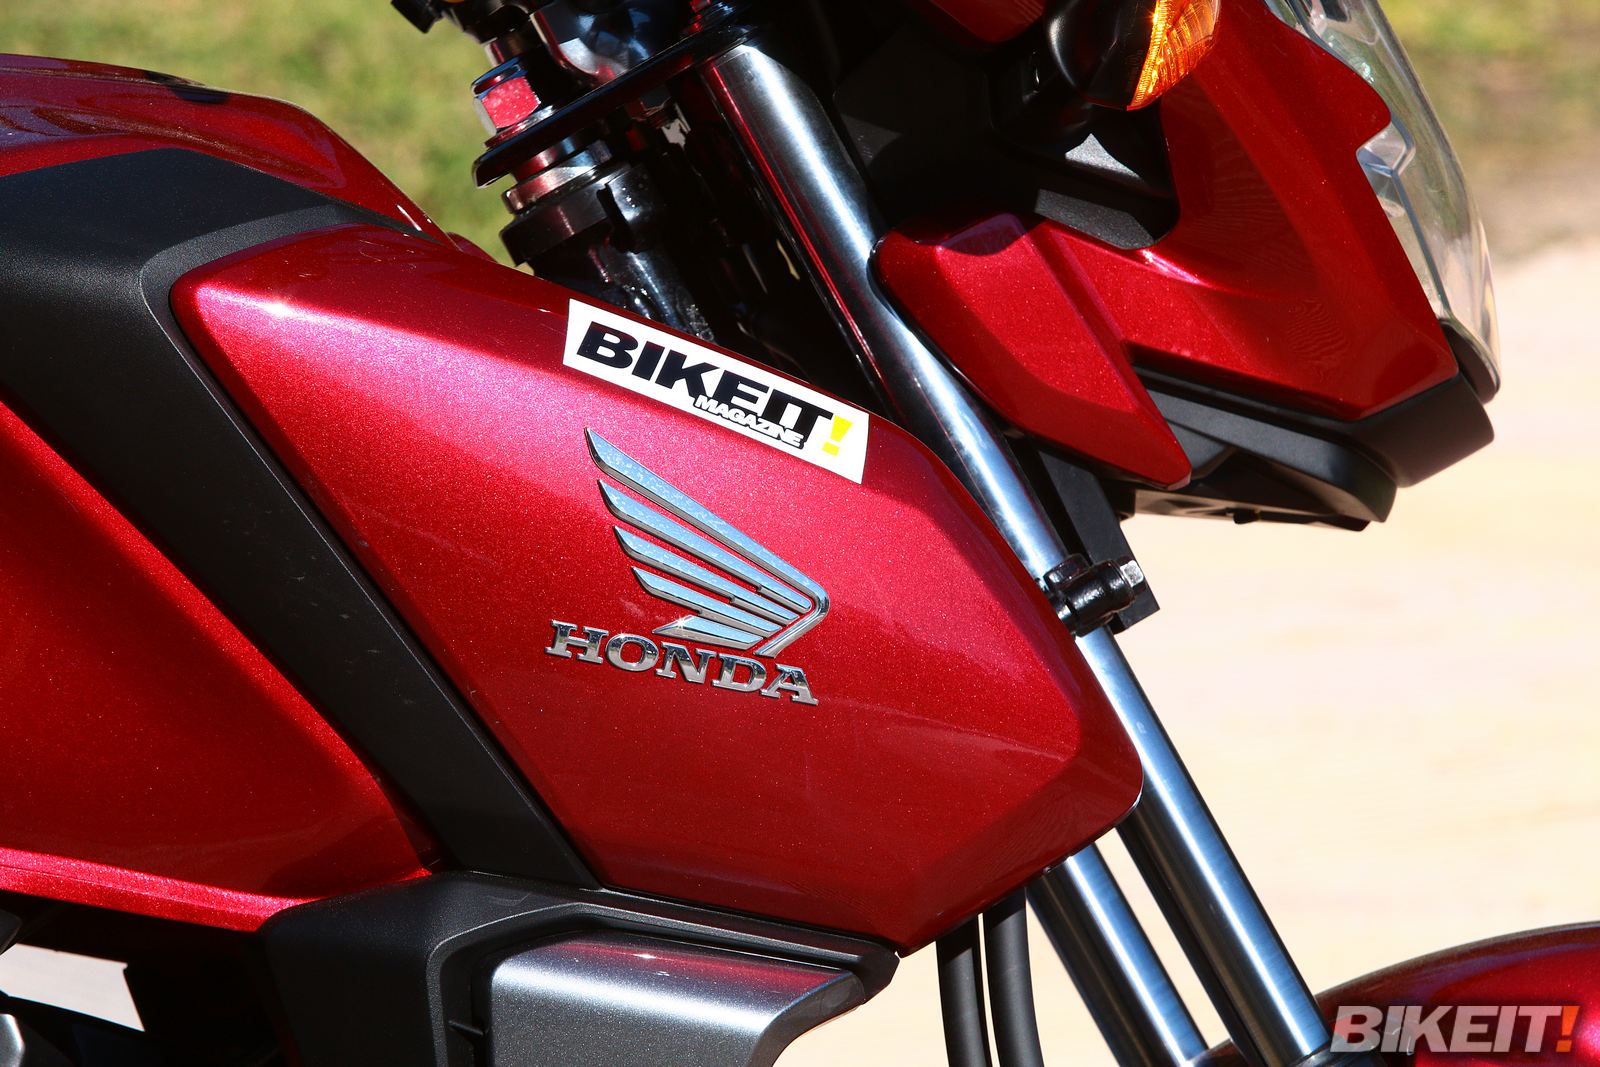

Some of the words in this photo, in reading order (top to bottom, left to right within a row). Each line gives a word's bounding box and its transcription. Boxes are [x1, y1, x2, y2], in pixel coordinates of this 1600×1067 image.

[576, 321, 853, 456] BIKEIT!
[694, 394, 805, 449] MAGAZINE
[545, 619, 819, 705] HONDA
